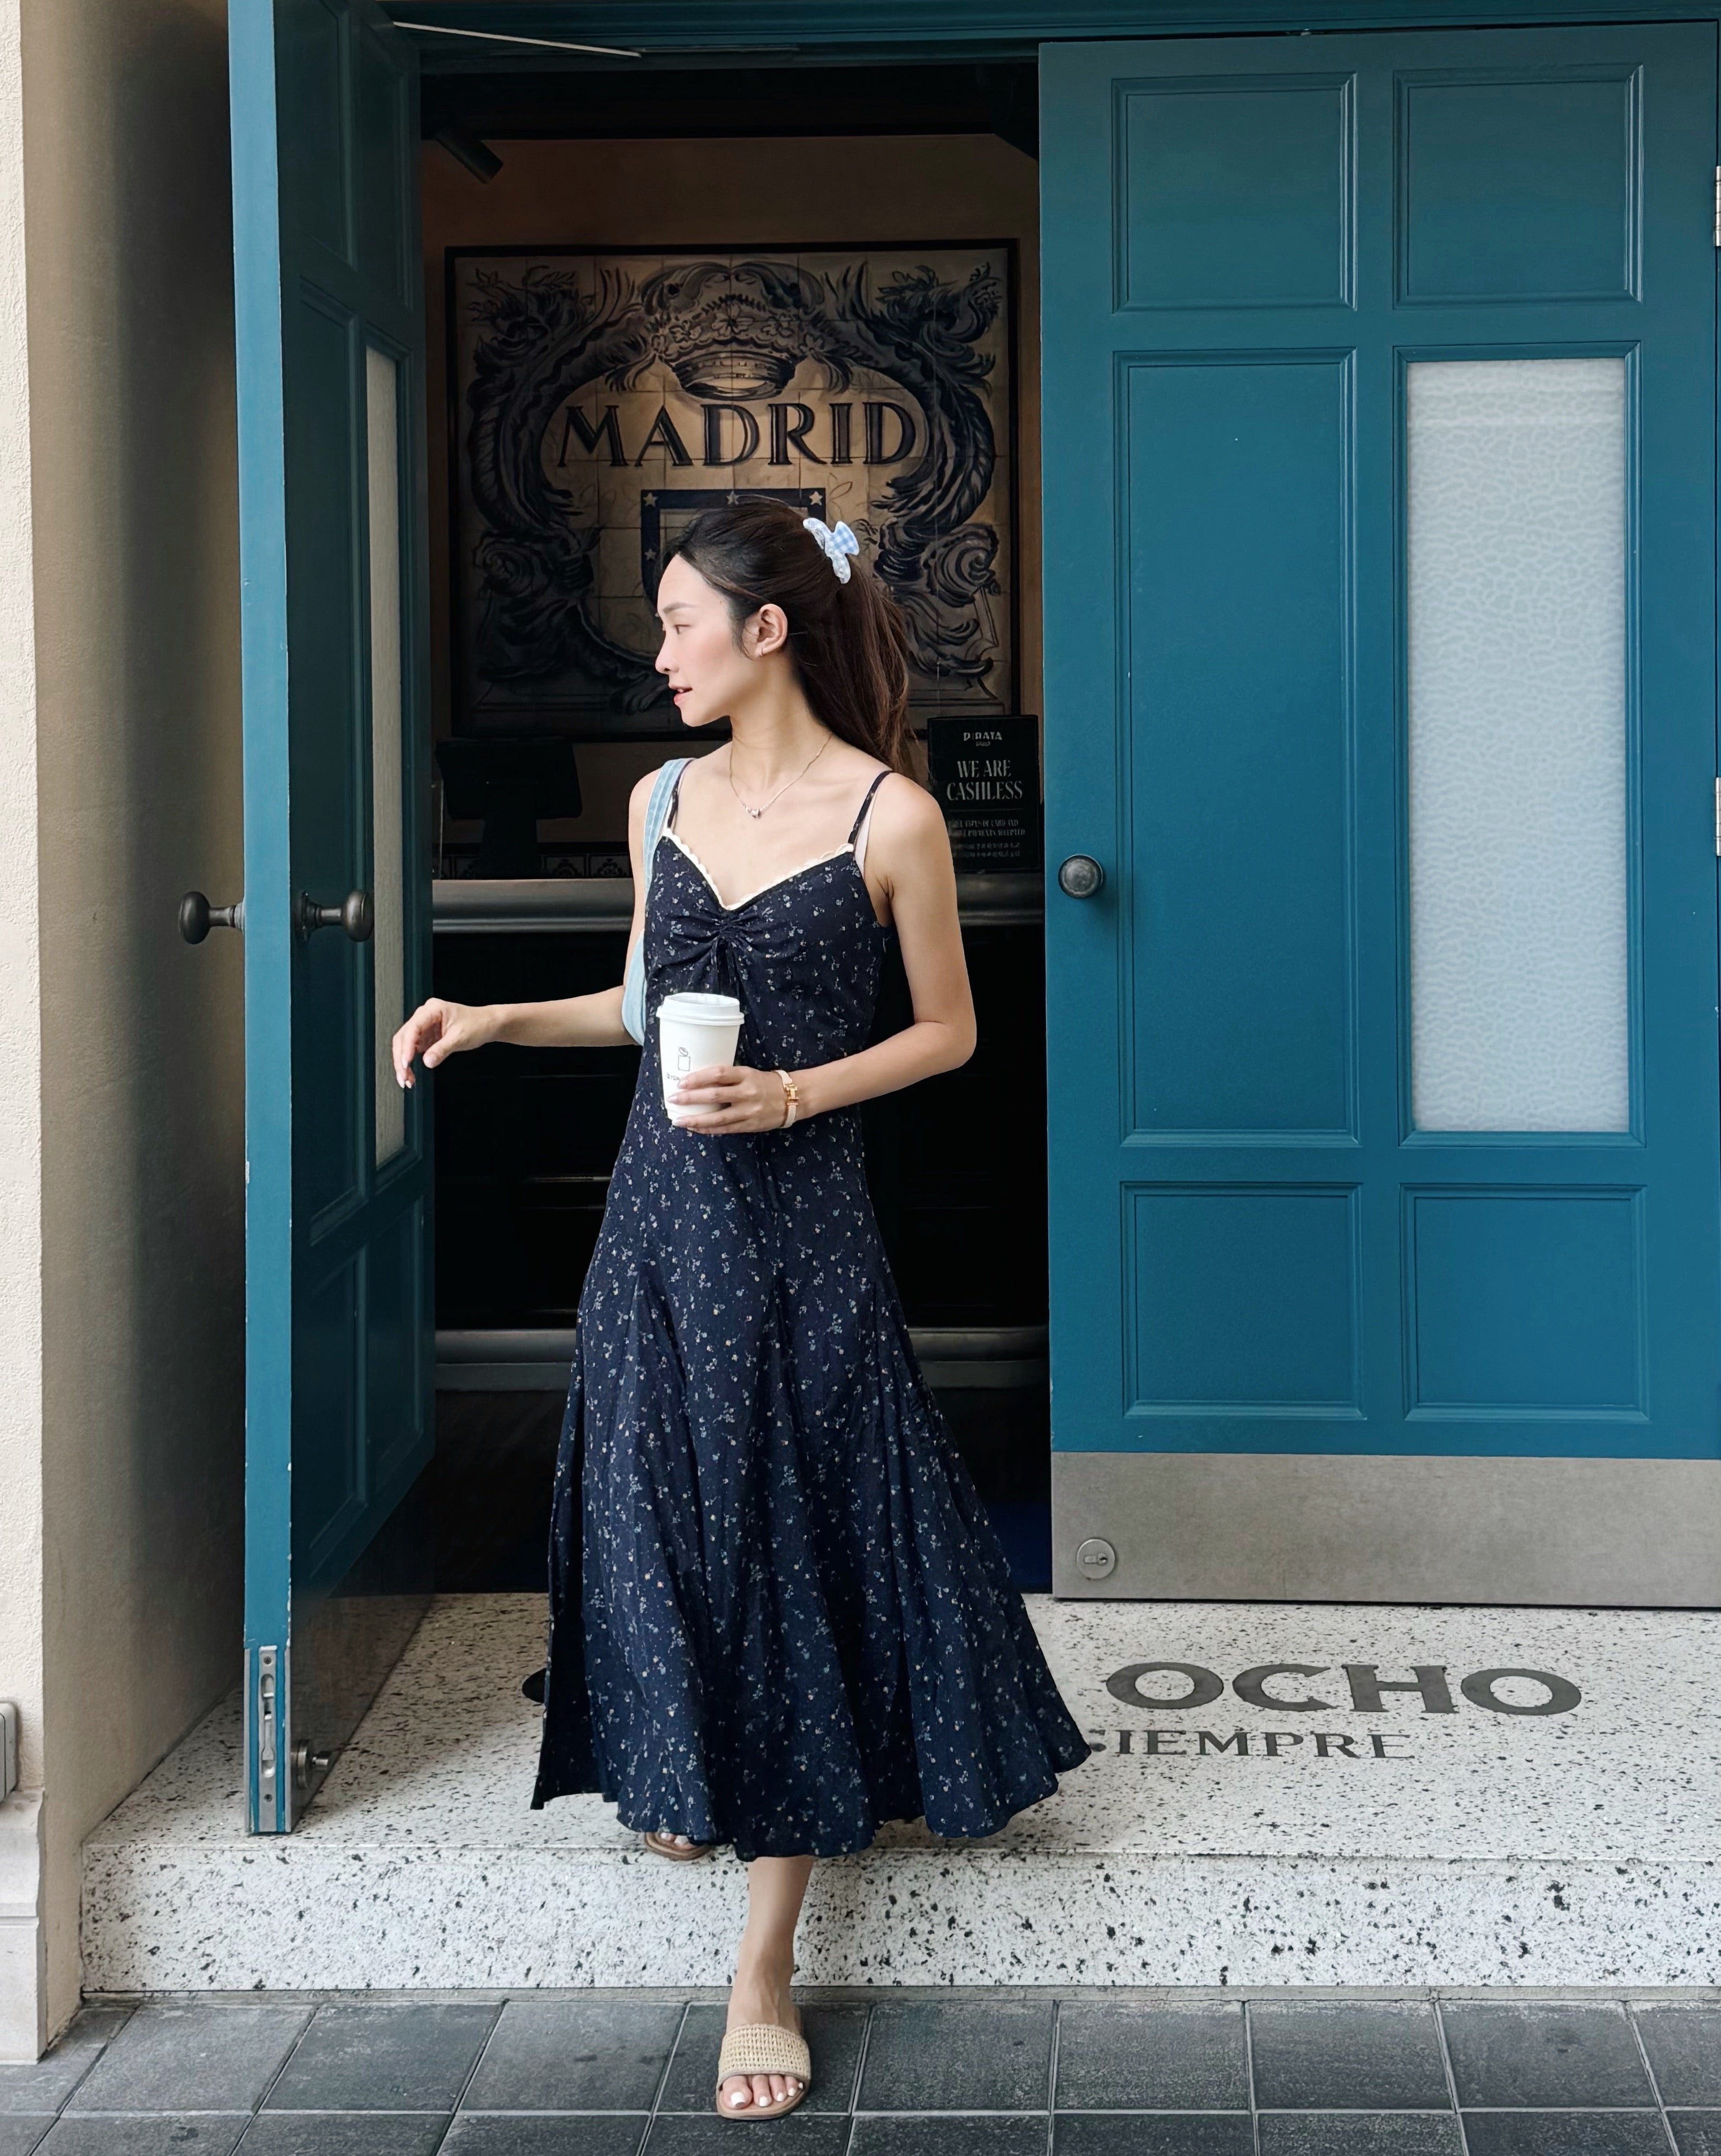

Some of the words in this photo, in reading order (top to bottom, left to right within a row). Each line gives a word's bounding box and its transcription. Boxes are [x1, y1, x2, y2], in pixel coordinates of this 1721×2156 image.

[559, 402, 916, 467] MADRID
[957, 760, 979, 778] WE
[983, 760, 1011, 777] ARE
[946, 780, 1023, 801] CASHLESS
[1106, 1662, 1582, 1715] OCHO
